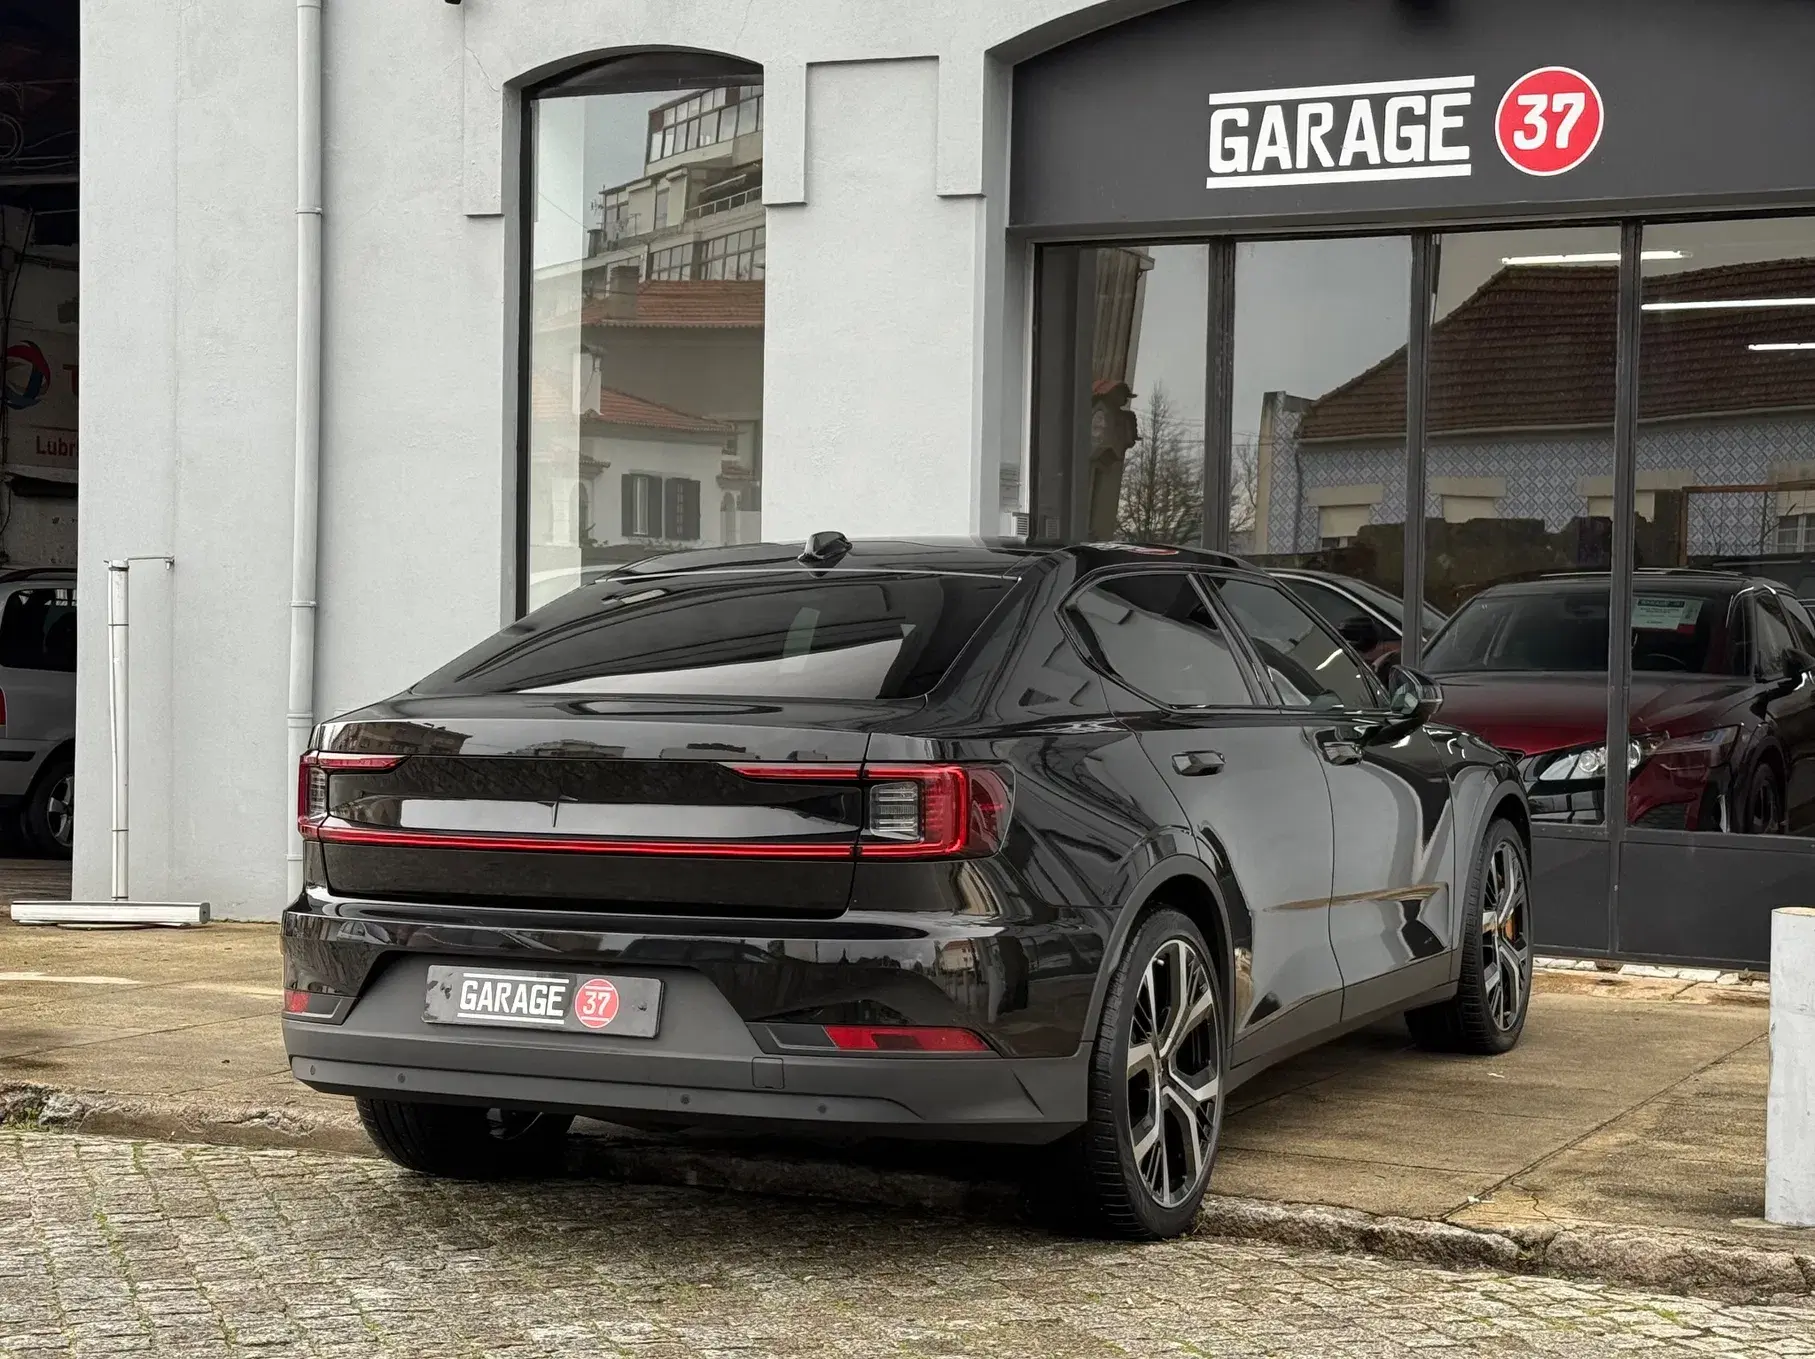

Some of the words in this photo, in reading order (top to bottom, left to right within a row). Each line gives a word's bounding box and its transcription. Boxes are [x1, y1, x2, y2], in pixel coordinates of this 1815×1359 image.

[1209, 92, 1472, 174] GARAGE
[1512, 92, 1586, 151] 37
[36, 436, 79, 456] Lubr
[460, 980, 566, 1017] GARAGE
[583, 990, 611, 1015] 37
